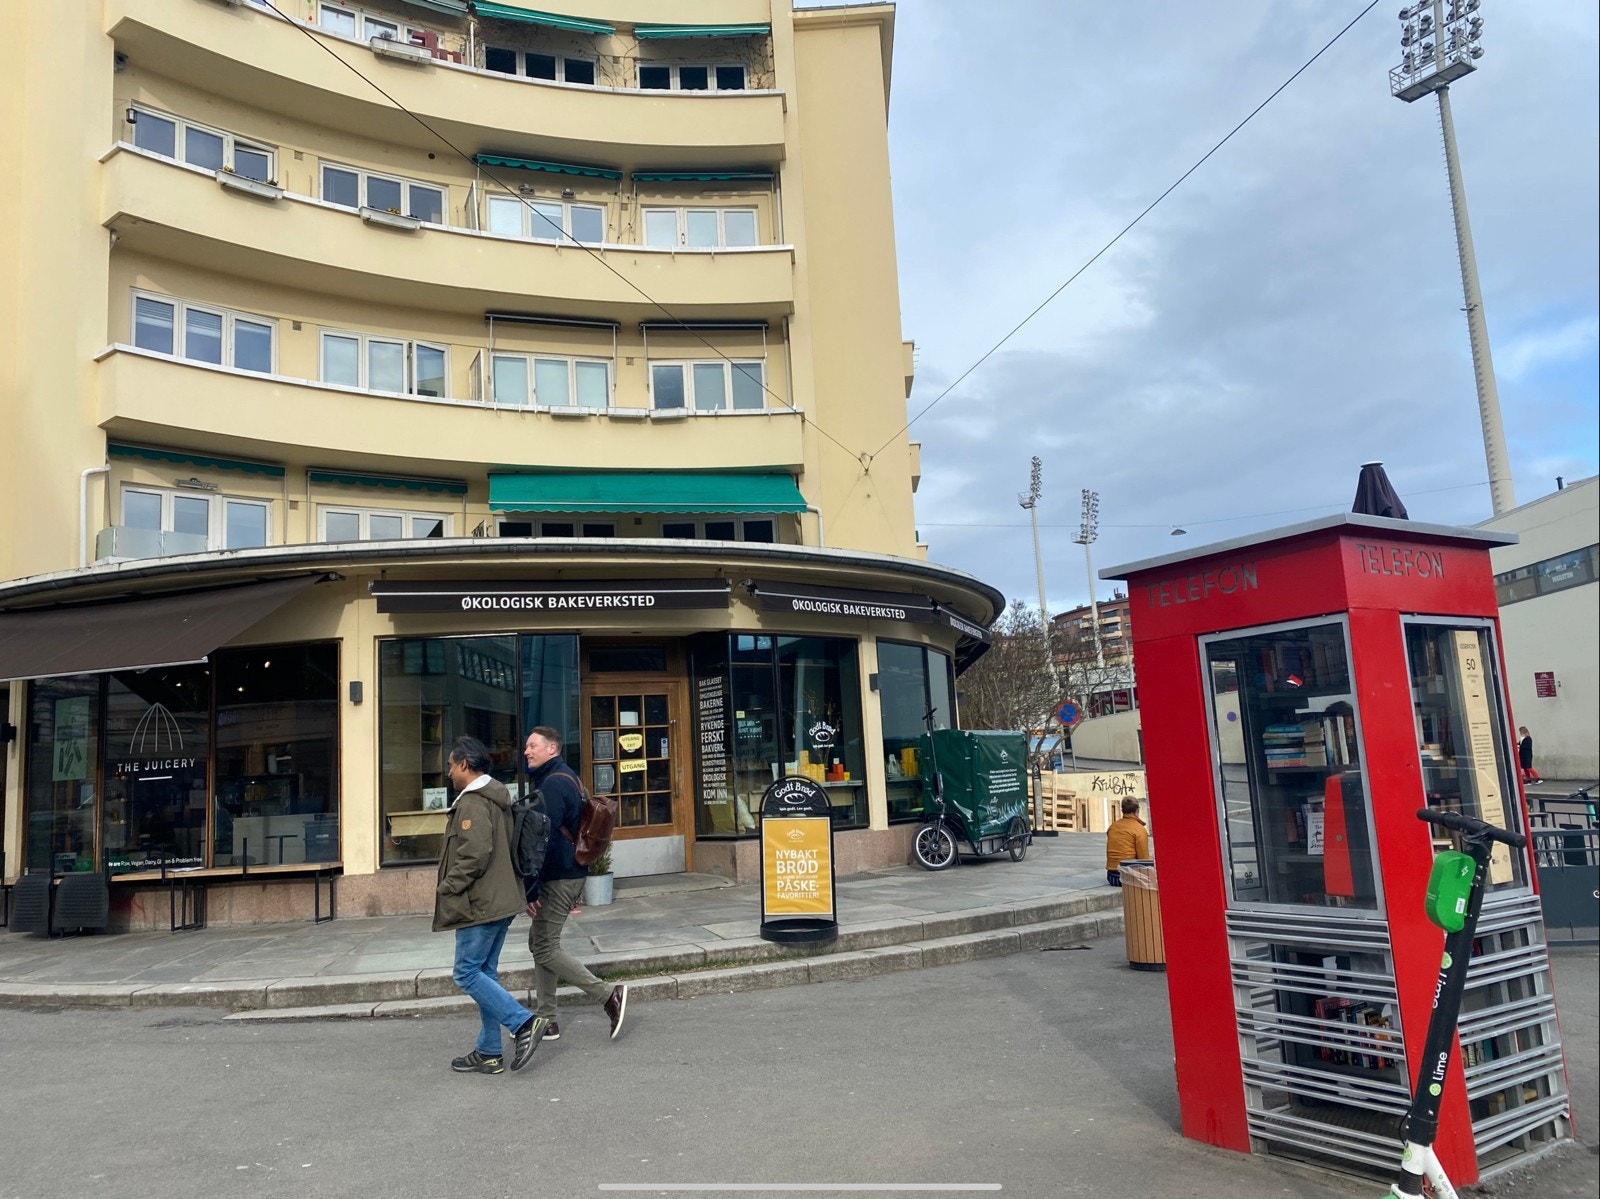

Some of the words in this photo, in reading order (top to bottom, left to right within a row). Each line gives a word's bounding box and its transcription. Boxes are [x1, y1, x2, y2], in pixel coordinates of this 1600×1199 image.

[1356, 543, 1444, 579] TELEFON
[1145, 561, 1257, 608] TELEFON
[461, 596, 544, 611] ØKOLOGISK
[548, 595, 655, 609] BAKEVERKSTED
[792, 598, 842, 614] ØKOLOGISK
[843, 604, 906, 619] BAKEVERKSTED
[1466, 658, 1476, 670] 50
[700, 697, 723, 710] BAKERNE
[701, 719, 724, 731] RYKENDE
[701, 730, 725, 744] FERSKT
[117, 762, 139, 772] THE
[144, 758, 196, 771] JUICERY
[703, 789, 716, 799] KOM
[717, 788, 728, 799] INN
[774, 782, 794, 798] Godt
[795, 782, 816, 797] Brød
[776, 849, 818, 859] NYBAKT
[776, 858, 819, 875] BRØD
[777, 878, 819, 891] PÅSKE-
[777, 891, 819, 899] FAVORITTER!
[1432, 1051, 1448, 1081] Lime
